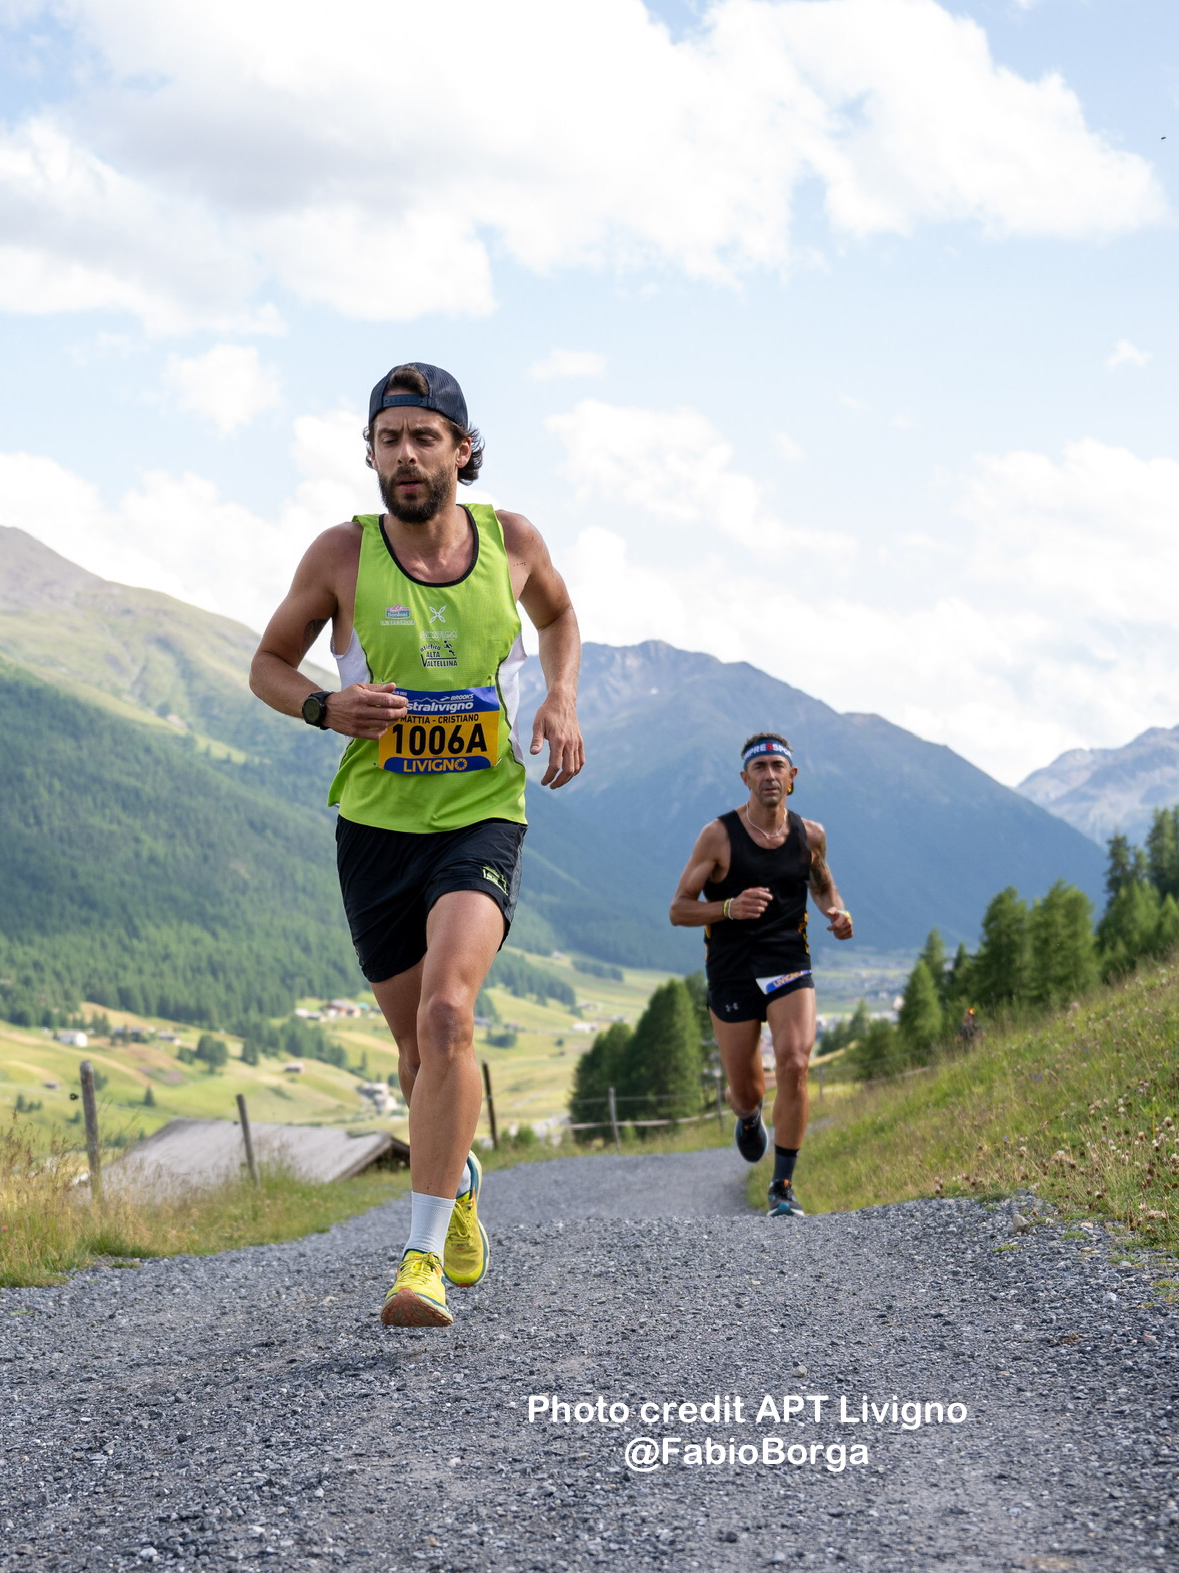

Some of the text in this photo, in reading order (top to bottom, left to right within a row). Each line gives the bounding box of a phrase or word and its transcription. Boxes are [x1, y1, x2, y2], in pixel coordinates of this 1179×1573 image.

[420, 654, 458, 667] VALTELLINA
[450, 693, 474, 701] BROOKS
[401, 715, 430, 724] MATTIA
[437, 713, 479, 724] CRISTIANO
[392, 723, 487, 756] 1006A
[403, 758, 468, 773] LIVIGNO
